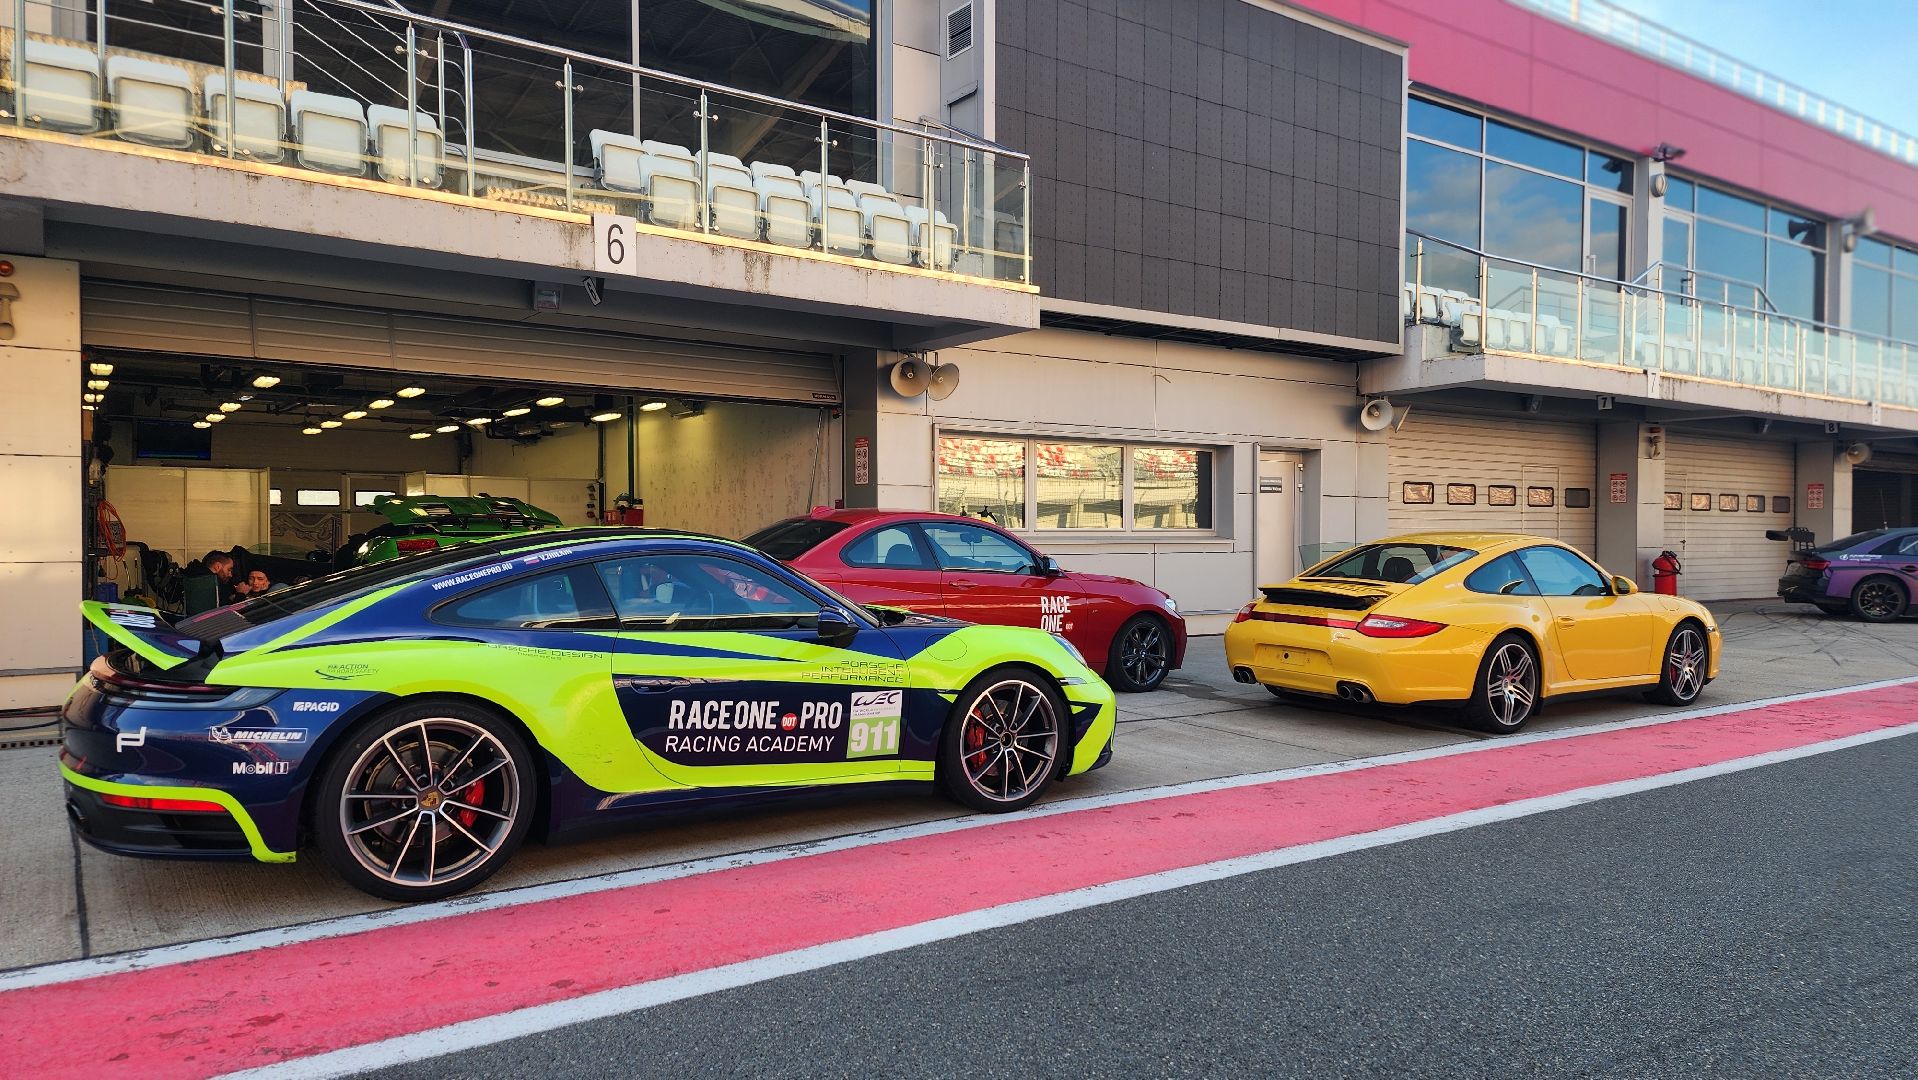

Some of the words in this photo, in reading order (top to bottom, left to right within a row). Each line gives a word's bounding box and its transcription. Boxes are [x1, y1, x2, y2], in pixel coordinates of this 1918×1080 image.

[608, 224, 625, 264] 6
[1651, 372, 1657, 393] 7
[1601, 397, 1607, 408] 7
[1828, 422, 1835, 432] 8
[432, 563, 513, 591] WWW.RACEONEPRO.RU
[1040, 596, 1071, 613] RACE
[1041, 614, 1064, 632] ONE
[551, 650, 603, 660] DESIGN
[841, 660, 904, 670] PORSCHE
[801, 671, 904, 683] PERFORMANCE
[853, 692, 901, 706] WEC
[303, 702, 340, 712] PAGID
[782, 716, 797, 728] DOT
[799, 701, 843, 729] PRO
[234, 730, 303, 740] MICHELIN
[850, 719, 898, 752] 911
[665, 735, 741, 753] RACING
[746, 735, 836, 753] ACADEMY
[232, 761, 273, 775] Mobil
